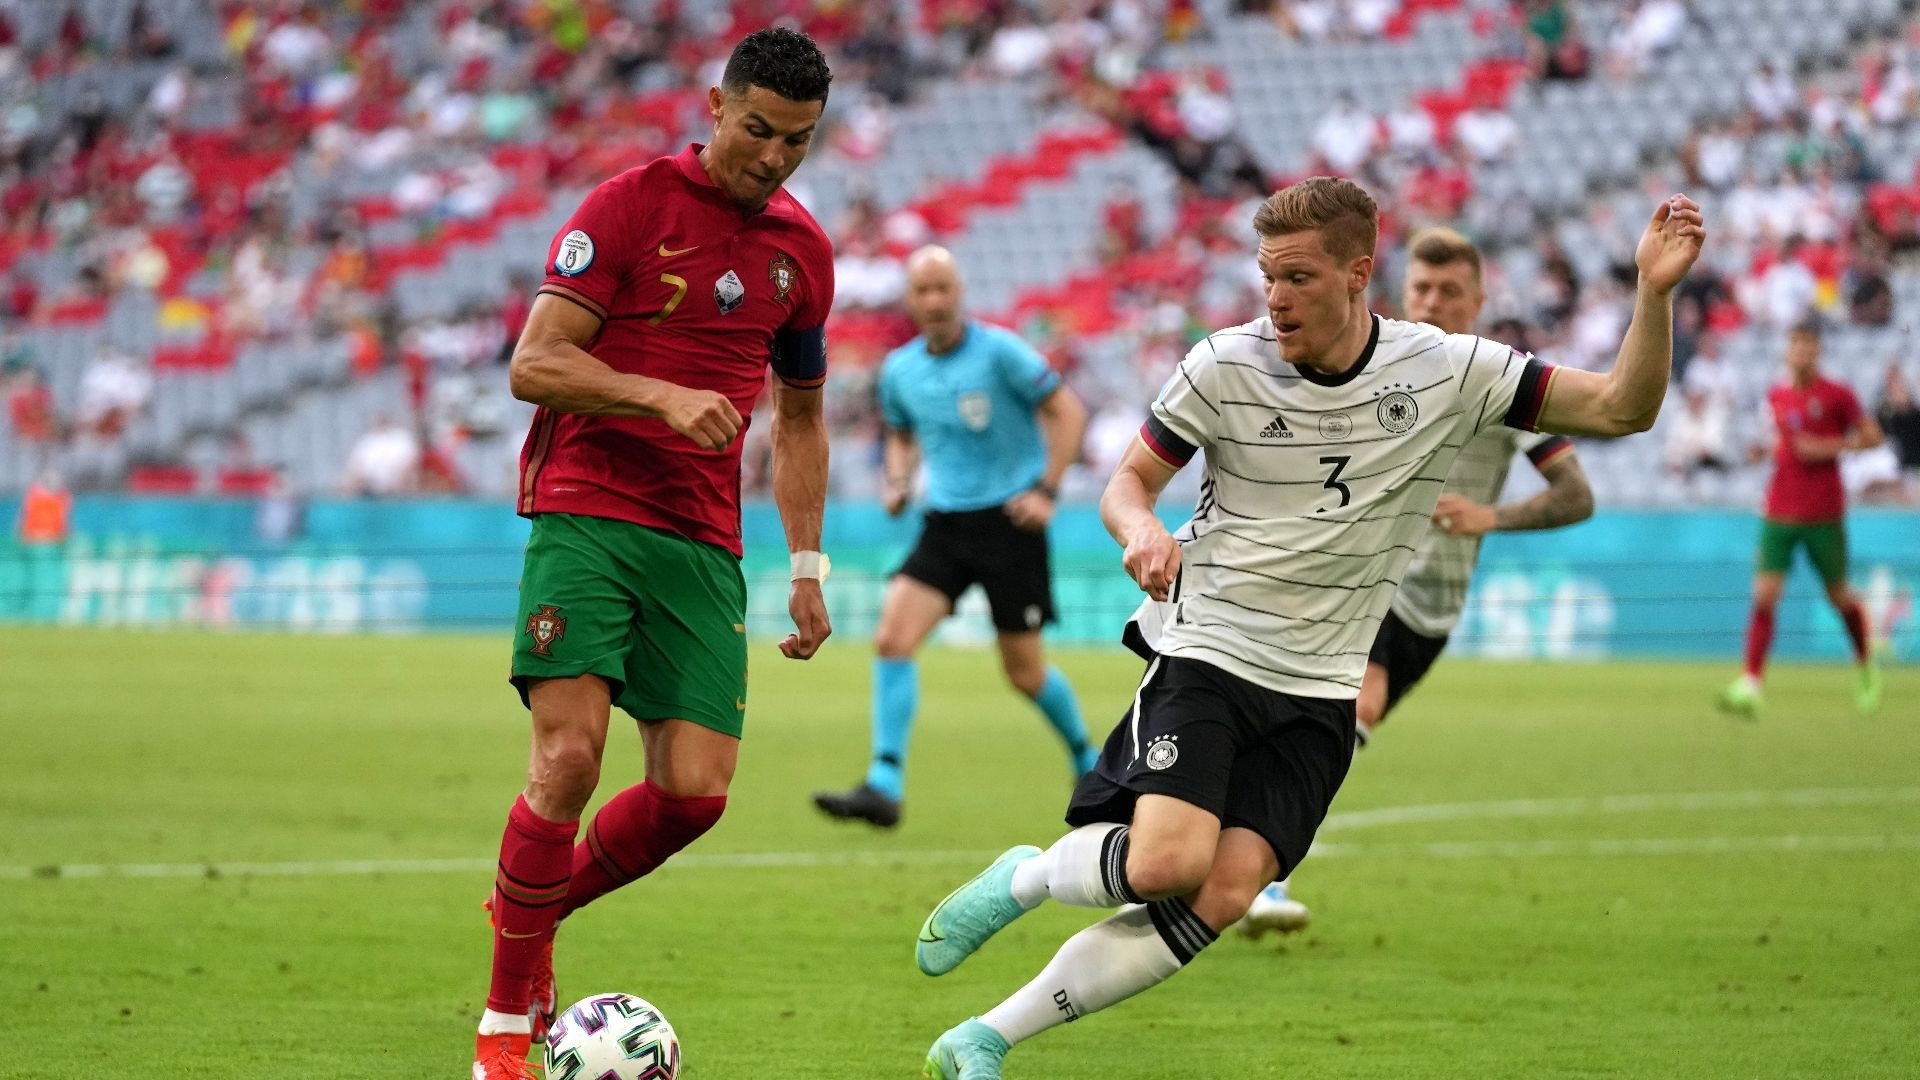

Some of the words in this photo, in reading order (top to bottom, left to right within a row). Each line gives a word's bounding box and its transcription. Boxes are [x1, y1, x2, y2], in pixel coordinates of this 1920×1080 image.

[649, 272, 688, 327] 7
[1259, 430, 1294, 439] adidas
[1316, 455, 1352, 513] 3
